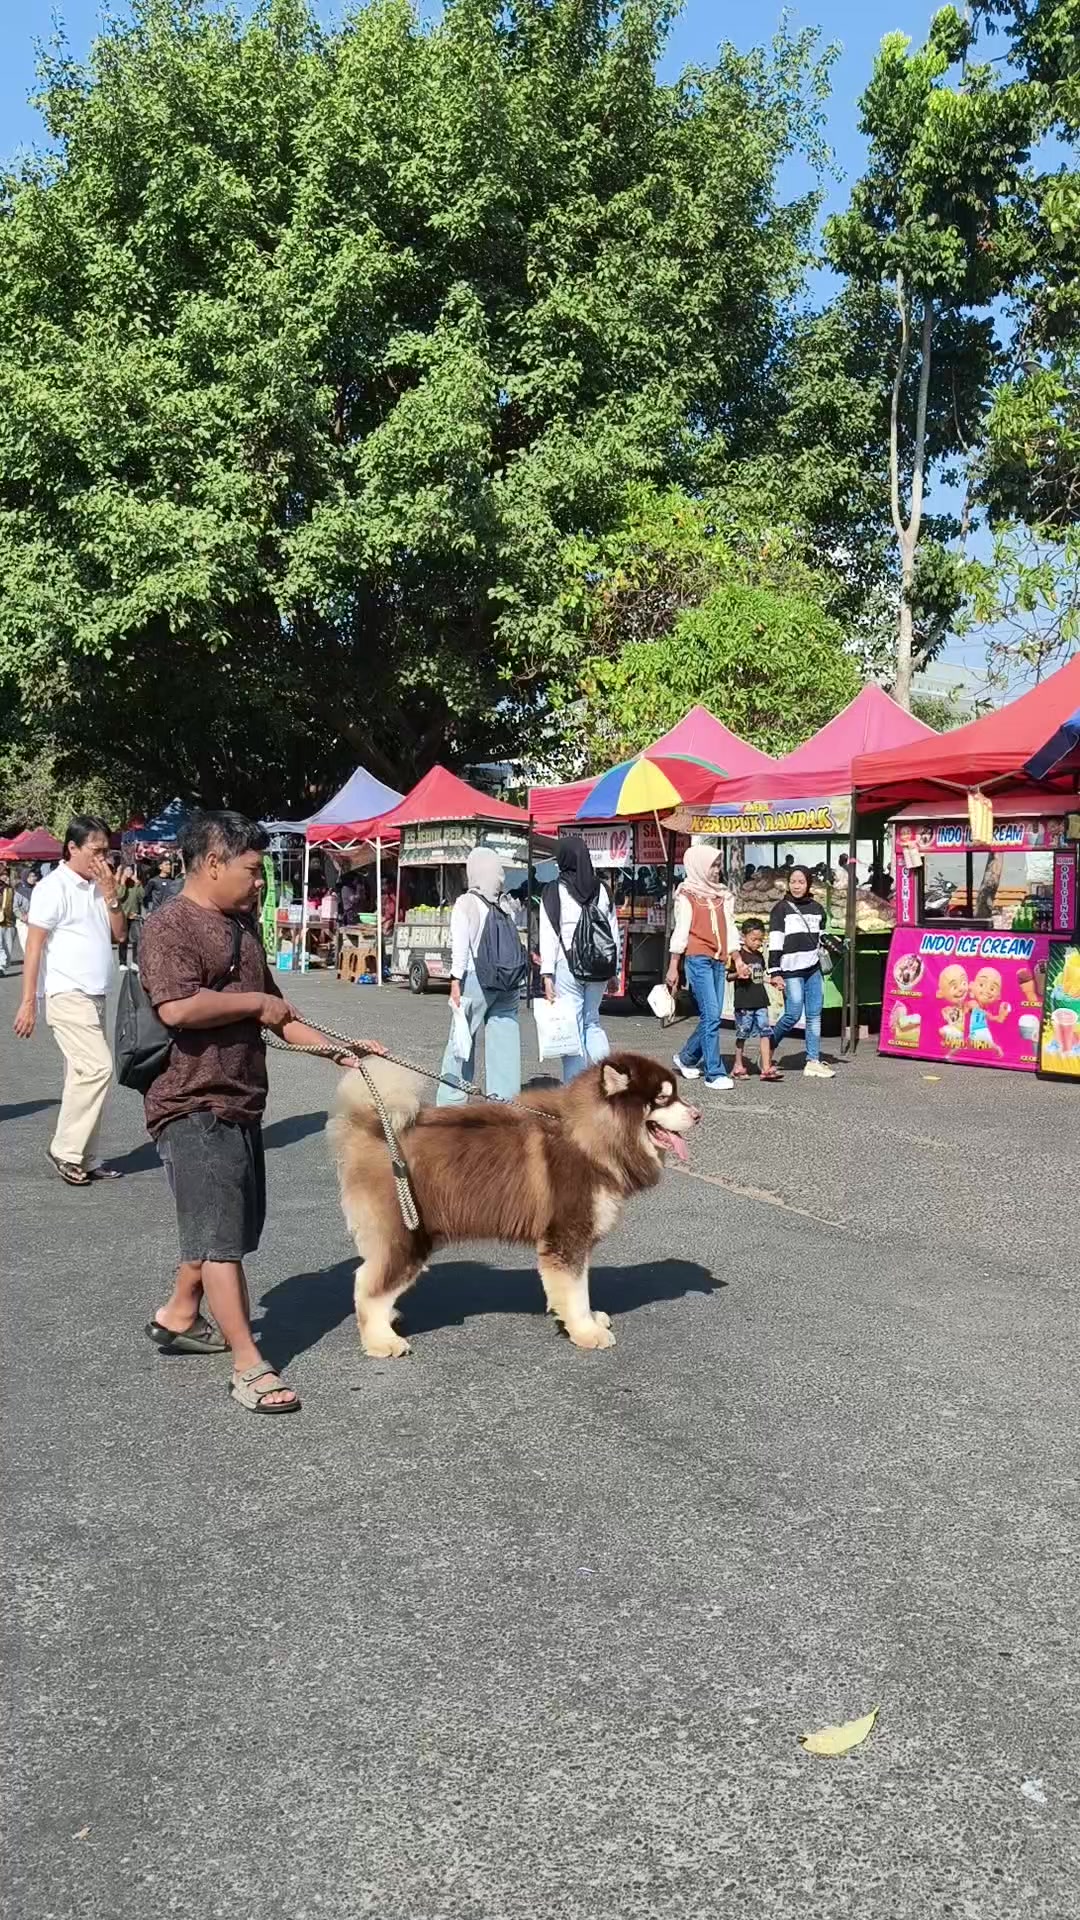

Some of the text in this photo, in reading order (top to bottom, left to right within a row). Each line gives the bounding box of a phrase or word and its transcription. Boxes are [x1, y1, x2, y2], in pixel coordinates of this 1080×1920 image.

[688, 807, 833, 833] KERUPUK RAMBAK
[936, 826, 962, 844] INDO
[992, 824, 1025, 844] REAM
[1060, 865, 1070, 929] ORIGINAL
[409, 926, 441, 948] JERUK
[921, 934, 1035, 958] INDO ICE CREAM
